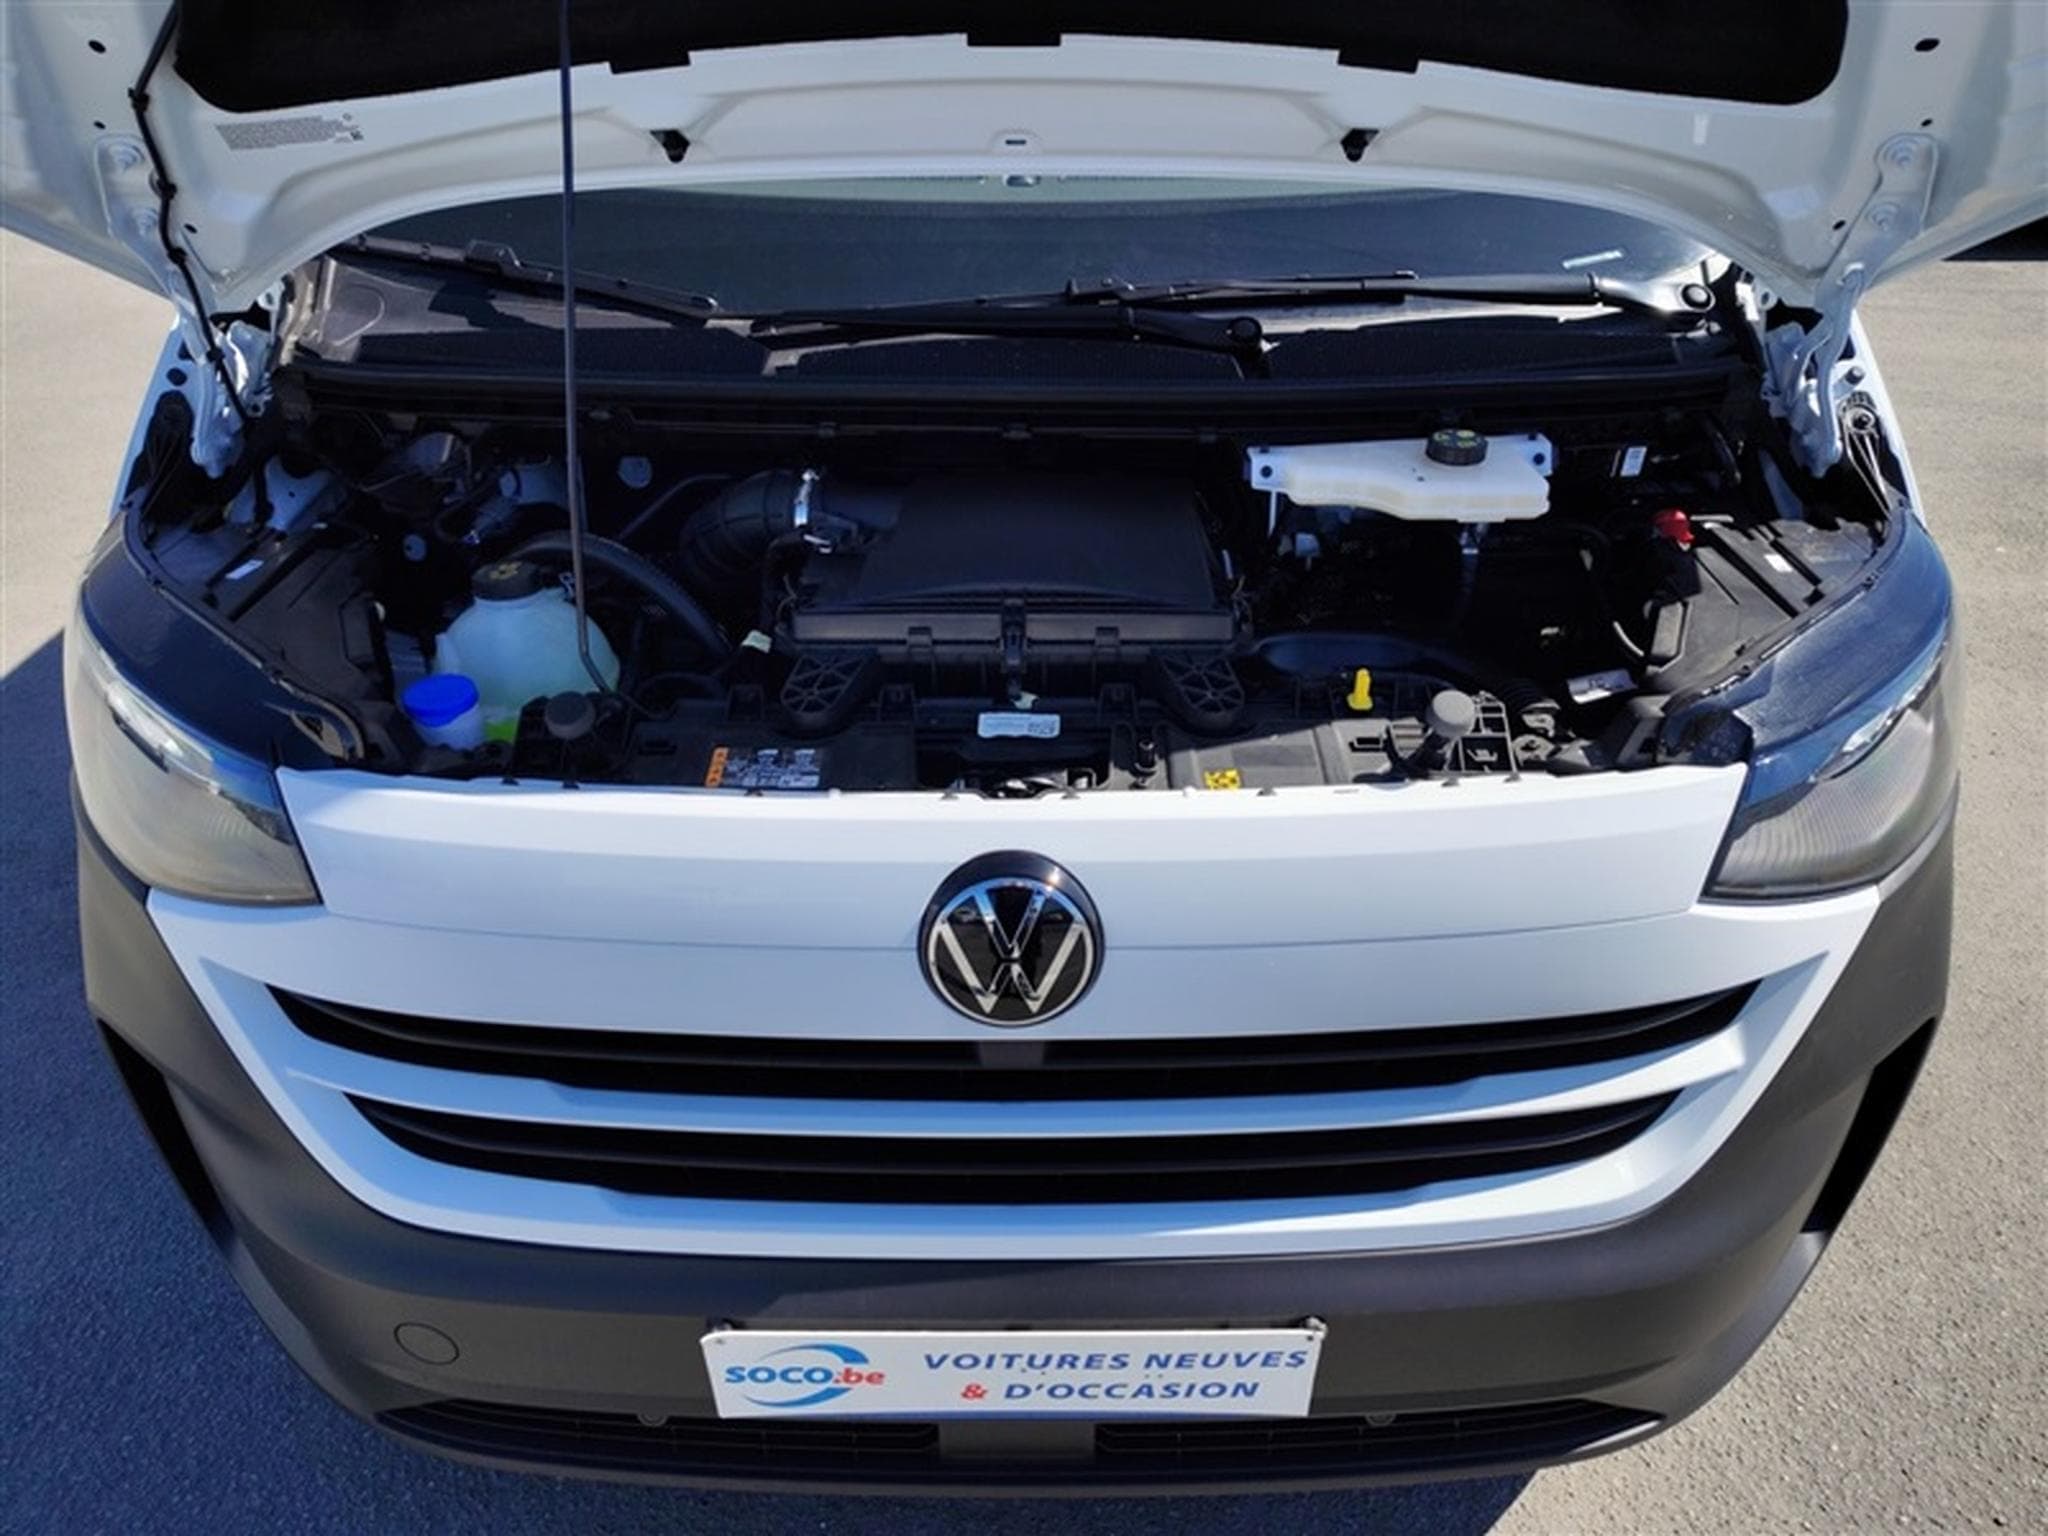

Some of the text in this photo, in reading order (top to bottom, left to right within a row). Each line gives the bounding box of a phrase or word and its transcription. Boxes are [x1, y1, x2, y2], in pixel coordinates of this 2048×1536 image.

[931, 885, 1091, 1015] VW
[924, 1351, 1308, 1370] VOITURES NEUVES
[961, 1381, 1260, 1400] & D'OCCASION
